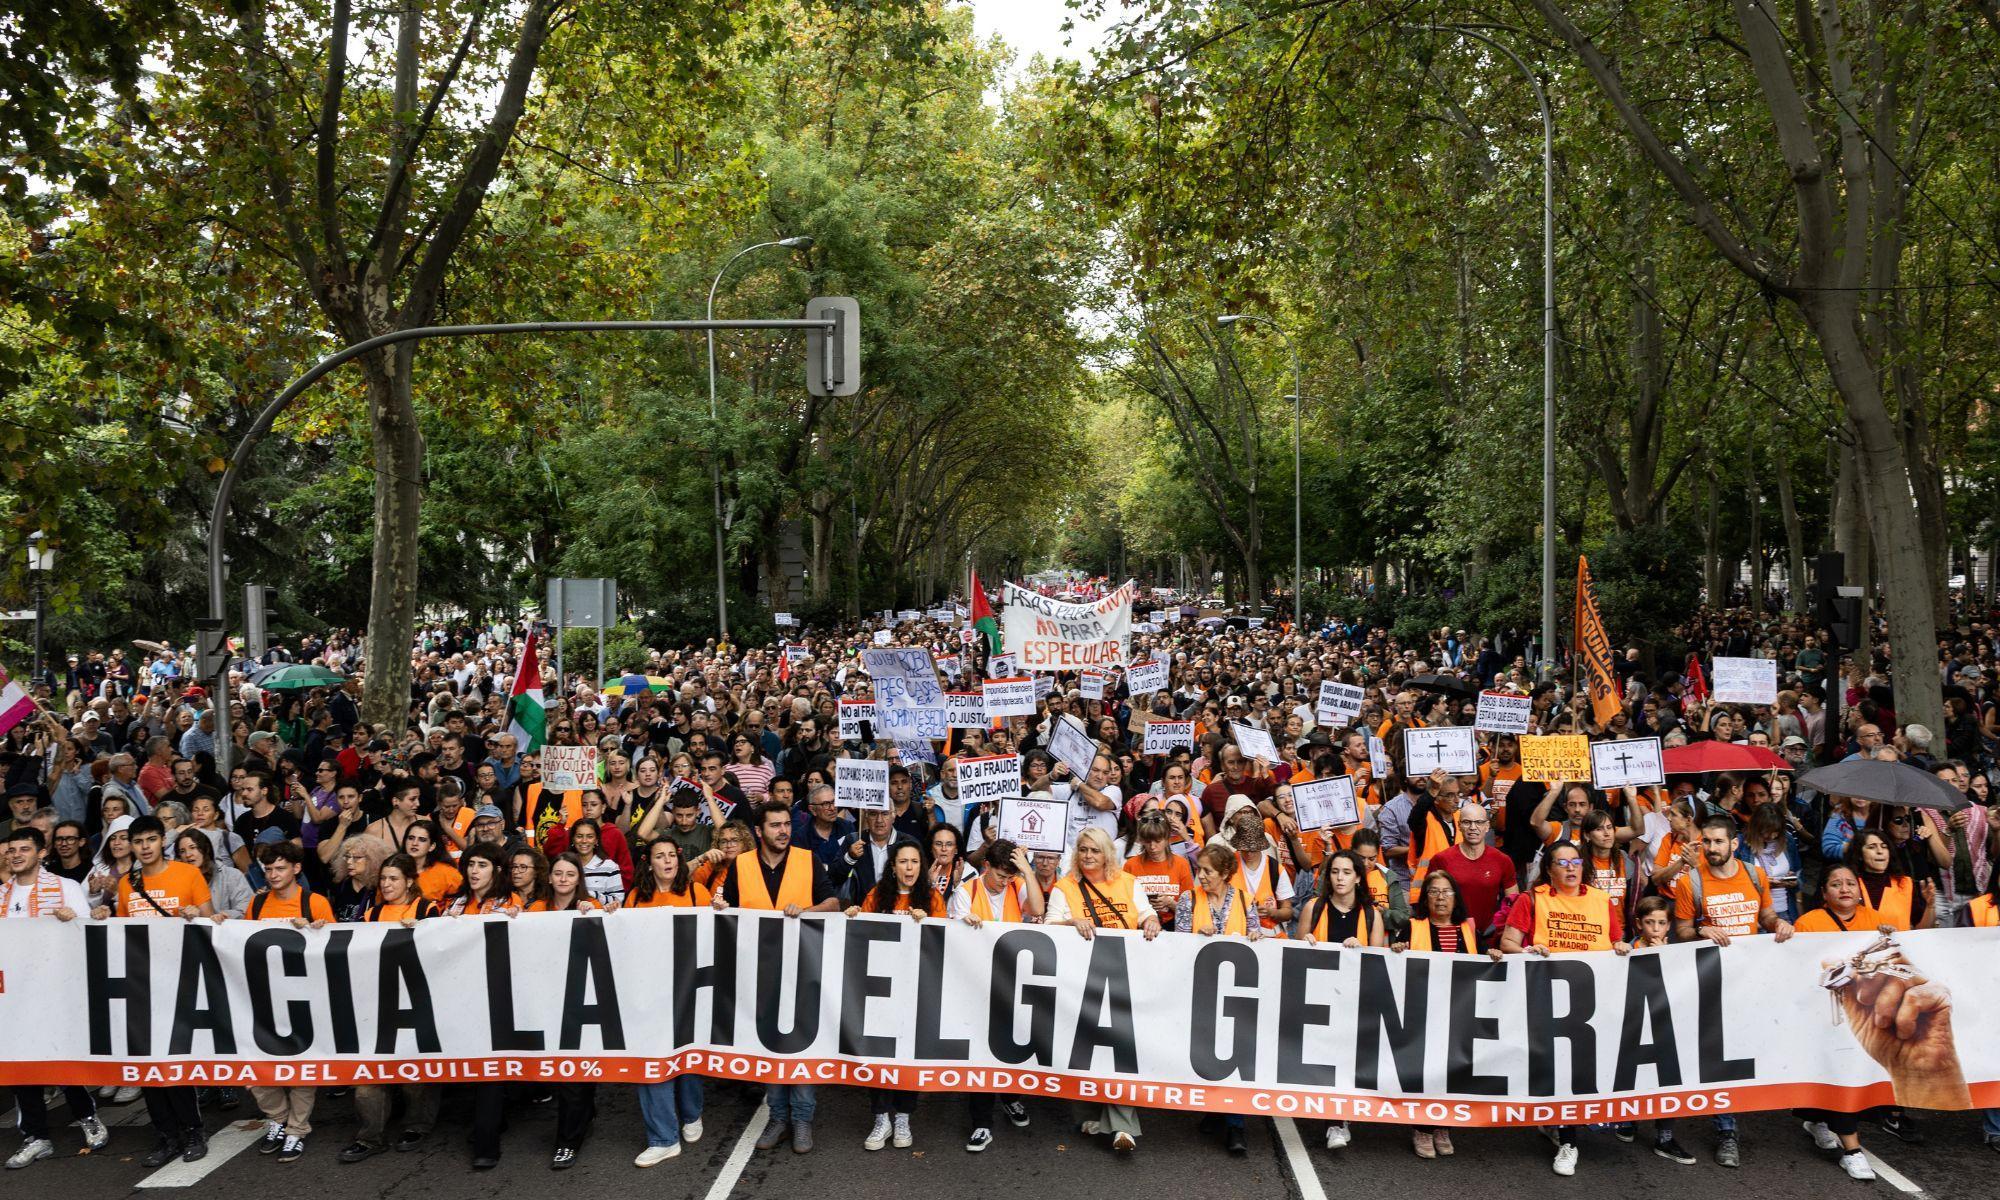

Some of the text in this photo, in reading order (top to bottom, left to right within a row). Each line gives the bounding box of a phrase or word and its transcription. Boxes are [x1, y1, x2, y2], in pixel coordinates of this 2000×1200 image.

[1036, 616, 1109, 641] NO PARA
[1024, 640, 1122, 665] ESPECULAR
[873, 677, 905, 699] TRES
[1130, 681, 1139, 692] LO
[945, 695, 984, 709] ¡PEDIMO
[841, 705, 876, 718] NO al FRA
[1147, 724, 1191, 738] ¡PEDIMOS
[1146, 739, 1158, 750] LO
[544, 746, 596, 760] AQUI NO
[544, 760, 595, 773] HAY QUIEN
[959, 758, 1019, 780] NO al FRAUDE
[1523, 758, 1581, 769] ESTAS CASAS
[1526, 768, 1545, 780] SON
[961, 777, 1020, 800] HIPOTECARIO!
[1709, 901, 1759, 916] DE INQUILINAS
[1548, 911, 1587, 922] SINDICATO
[1549, 930, 1597, 942] E INQUILINOS
[1548, 939, 1589, 951] DE MADRID
[86, 913, 1756, 1097] HACIA LA HUELGA GENERAL
[122, 1063, 258, 1083] BAJADA
[274, 1063, 338, 1082] DEL
[352, 1060, 524, 1082] ALQUILER
[539, 1059, 604, 1078] 50%
[644, 1052, 899, 1085] EXPROPIACIÓN
[918, 1069, 1062, 1093] FONDOS
[1079, 1080, 1206, 1107] BUITRE
[1251, 1092, 1473, 1122] CONTRATOS
[1491, 1091, 1731, 1123] INDEFINIDOS
